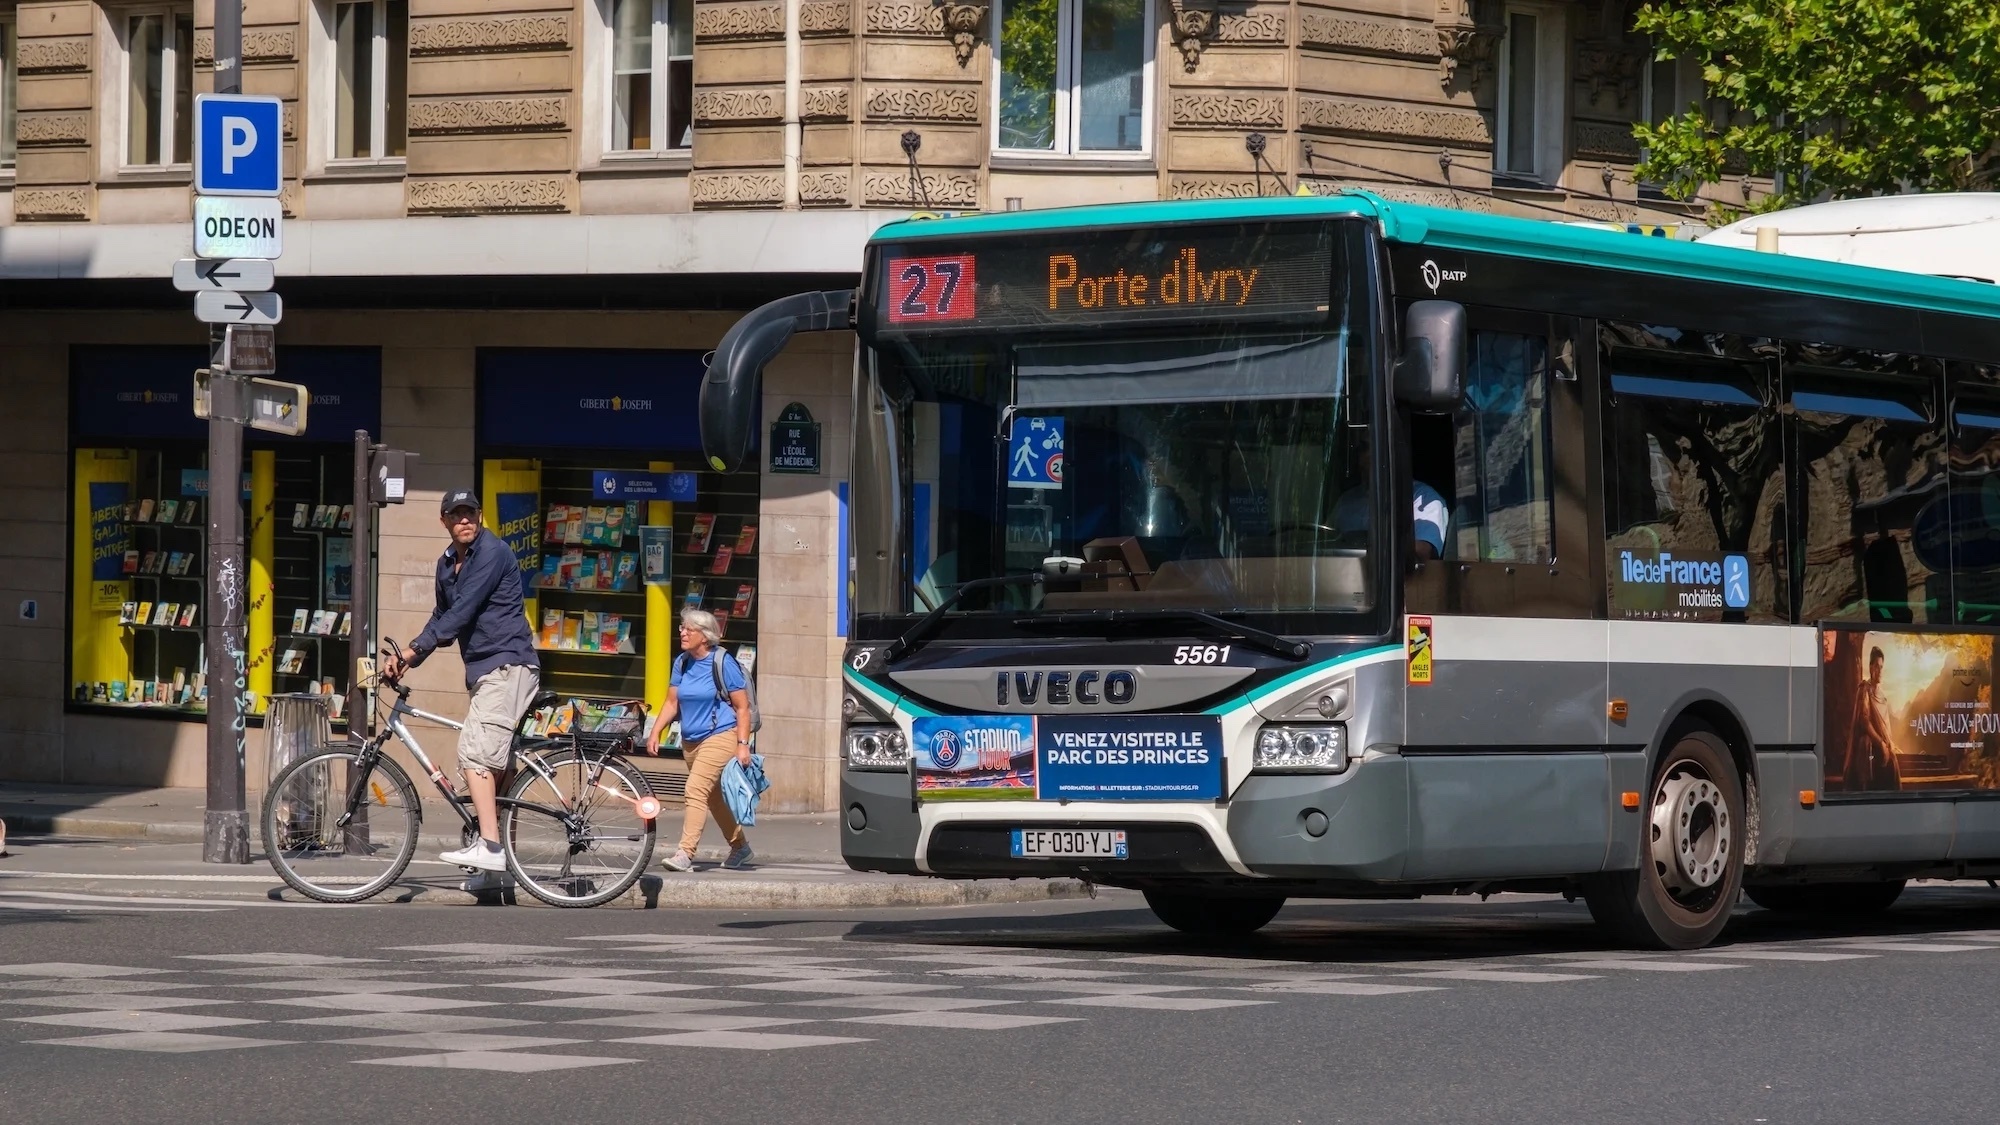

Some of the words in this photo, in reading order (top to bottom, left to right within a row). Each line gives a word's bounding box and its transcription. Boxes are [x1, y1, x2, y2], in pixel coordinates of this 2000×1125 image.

[222, 116, 258, 175] P
[205, 217, 275, 239] ODEON
[1049, 254, 1149, 310] Porte
[1160, 247, 1259, 307] d'Ivry
[1441, 270, 1467, 282] RATP
[900, 262, 963, 316] 27
[117, 393, 142, 401] GIBERT
[152, 393, 178, 402] JOSEPH
[312, 395, 341, 405] JOSEPH
[580, 398, 610, 409] GIBERT
[621, 399, 652, 410] JOSEPH
[789, 429, 800, 438] RUE
[783, 445, 806, 455] L'ÉCOLE
[775, 457, 783, 465] DE
[784, 456, 814, 466] MÉDECINE
[99, 584, 120, 596] -10%
[1678, 588, 1722, 607] mobilités
[1173, 645, 1231, 665] 5561
[997, 670, 1138, 706] IVECO
[1916, 713, 1970, 736] ANNEAUX
[935, 731, 956, 742] PARIS
[964, 728, 1021, 752] STADIUM
[1053, 733, 1108, 748] VENEZ
[1110, 732, 1177, 747] VISITER
[1181, 732, 1203, 747] LE
[977, 748, 1012, 771] TOUR
[1048, 750, 1092, 765] PARC
[1095, 750, 1129, 765] DES
[1132, 749, 1209, 764] PRINCES
[1015, 844, 1020, 852] F
[1116, 843, 1126, 855] 75
